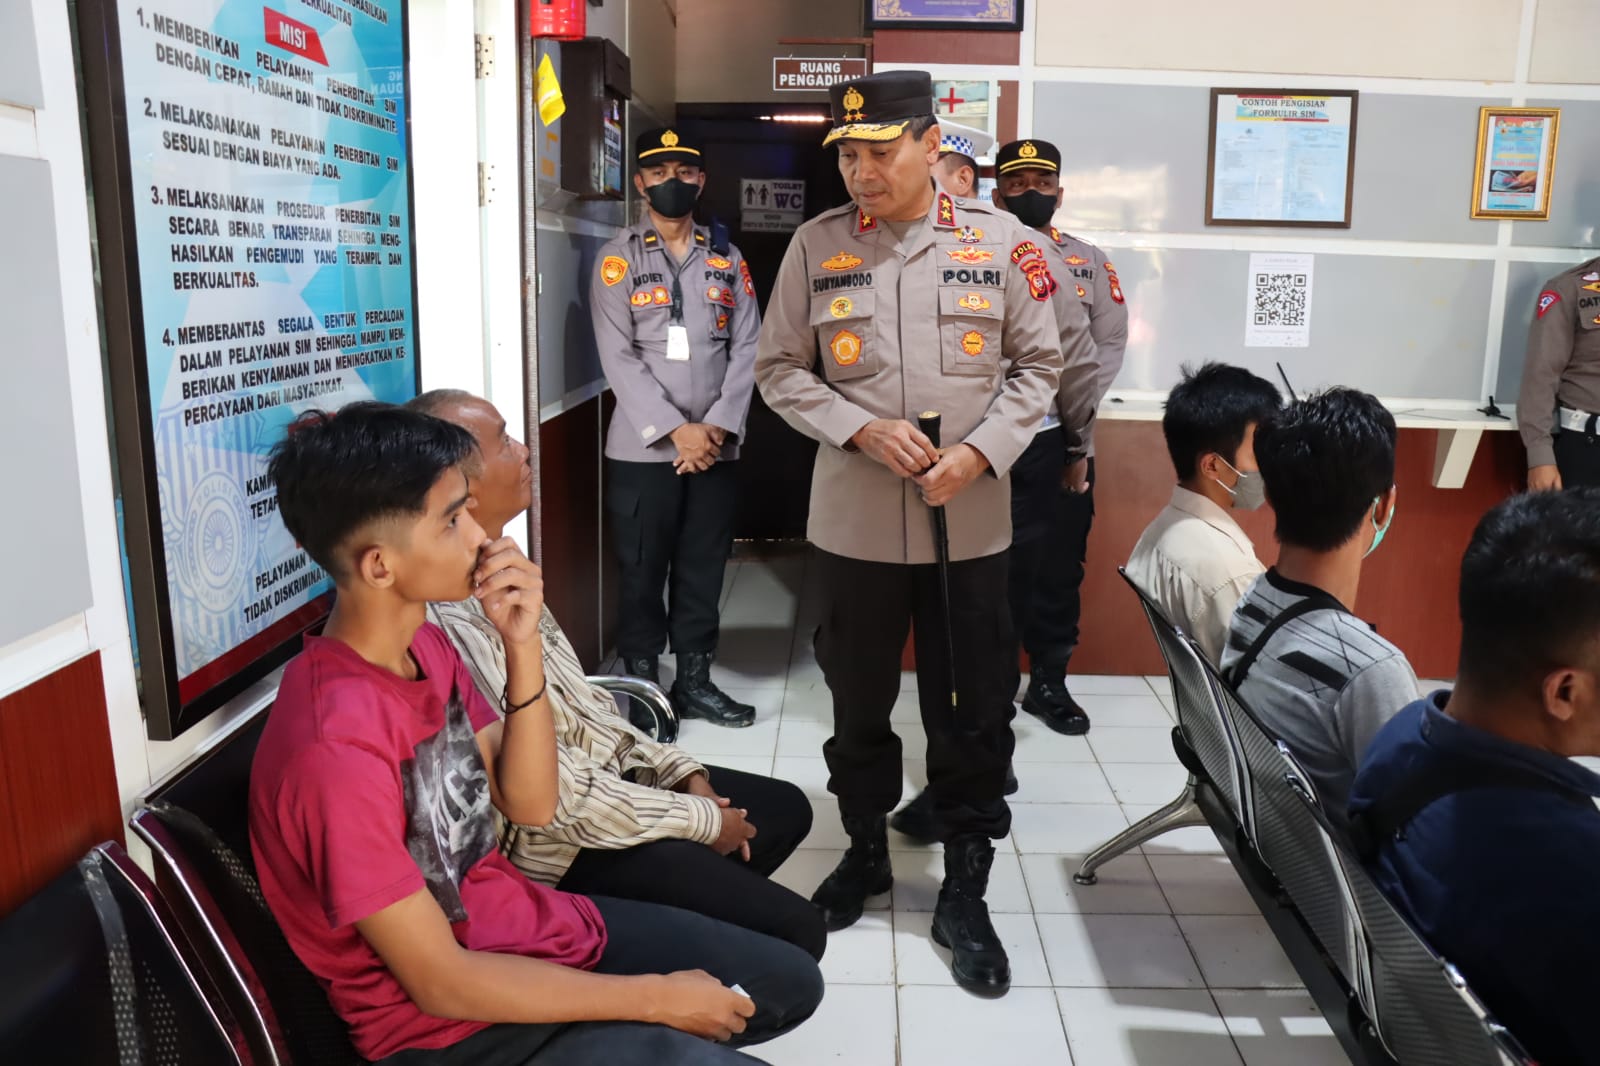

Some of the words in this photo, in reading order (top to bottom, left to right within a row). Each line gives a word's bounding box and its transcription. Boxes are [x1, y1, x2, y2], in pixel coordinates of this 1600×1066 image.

[279, 21, 307, 50] MISI
[137, 7, 150, 29] 1.
[153, 12, 240, 60] MEMBERIKAN
[256, 51, 314, 86] PELAYANAN
[327, 77, 375, 106] PENERBITAN
[384, 98, 397, 114] SIM
[800, 62, 841, 73] RUANG
[155, 42, 211, 77] DENGAN
[215, 62, 255, 94] CEPAT,
[257, 76, 293, 101] RAMAH
[295, 89, 314, 108] DAN
[316, 95, 341, 117] TIDAK
[1241, 98, 1278, 106] CONTOH
[1280, 99, 1326, 107] PENGISIAN
[1252, 109, 1297, 118] FORMULIR
[1300, 110, 1316, 118] SIM
[143, 97, 157, 119] 2.
[160, 101, 260, 141] MELAKSANAKAN
[271, 128, 325, 155] PELAYANAN
[333, 143, 380, 167] PENERBITAN
[386, 156, 398, 171] SIM
[162, 130, 210, 156] SESUAI
[213, 140, 260, 165] DENGAN
[262, 150, 293, 171] BIAYA
[295, 156, 320, 176] YANG
[322, 162, 341, 180] ADA.
[150, 185, 164, 205] 3.
[167, 187, 264, 215] MELAKSANAKAN
[277, 201, 326, 220] PROSEDUR
[335, 207, 381, 226] PENERBITAN
[388, 214, 400, 228] SIM
[774, 193, 802, 209] WC
[169, 216, 220, 236] SECARA
[228, 220, 265, 239] BENAR
[272, 224, 332, 242] TRANSPARAN
[338, 229, 376, 245] SEHINGGA
[171, 243, 234, 262] HASILKAN
[246, 246, 304, 264] PENGEMUDI
[314, 249, 337, 264] YANG
[346, 250, 381, 265] TERAMPIL
[388, 252, 402, 265] DAN
[173, 271, 259, 290] BERKUALITAS.
[943, 268, 1000, 286] POLRI
[162, 328, 175, 347] 4.
[178, 320, 265, 346] MEMBERANTAS
[278, 316, 314, 334] SEGALA
[324, 313, 356, 329] BENTUK
[365, 309, 405, 325] PERCALOAN
[180, 350, 222, 373] DALAM
[229, 341, 290, 365] PELAYANAN
[295, 338, 311, 355] SIM
[316, 333, 357, 352] SEHINGGA
[361, 329, 386, 345] MAMPU
[182, 374, 236, 400] BERIKAN
[241, 361, 310, 388] KENYAMANAN
[314, 357, 331, 374] DAN
[335, 349, 393, 371] MENINGKATKAN
[184, 395, 254, 427] PERCAYAAN
[257, 390, 281, 410] DARI
[283, 377, 344, 403] MASYARAKAT.
[255, 552, 306, 592] PELAYANAN
[244, 595, 272, 624] TIDAK
